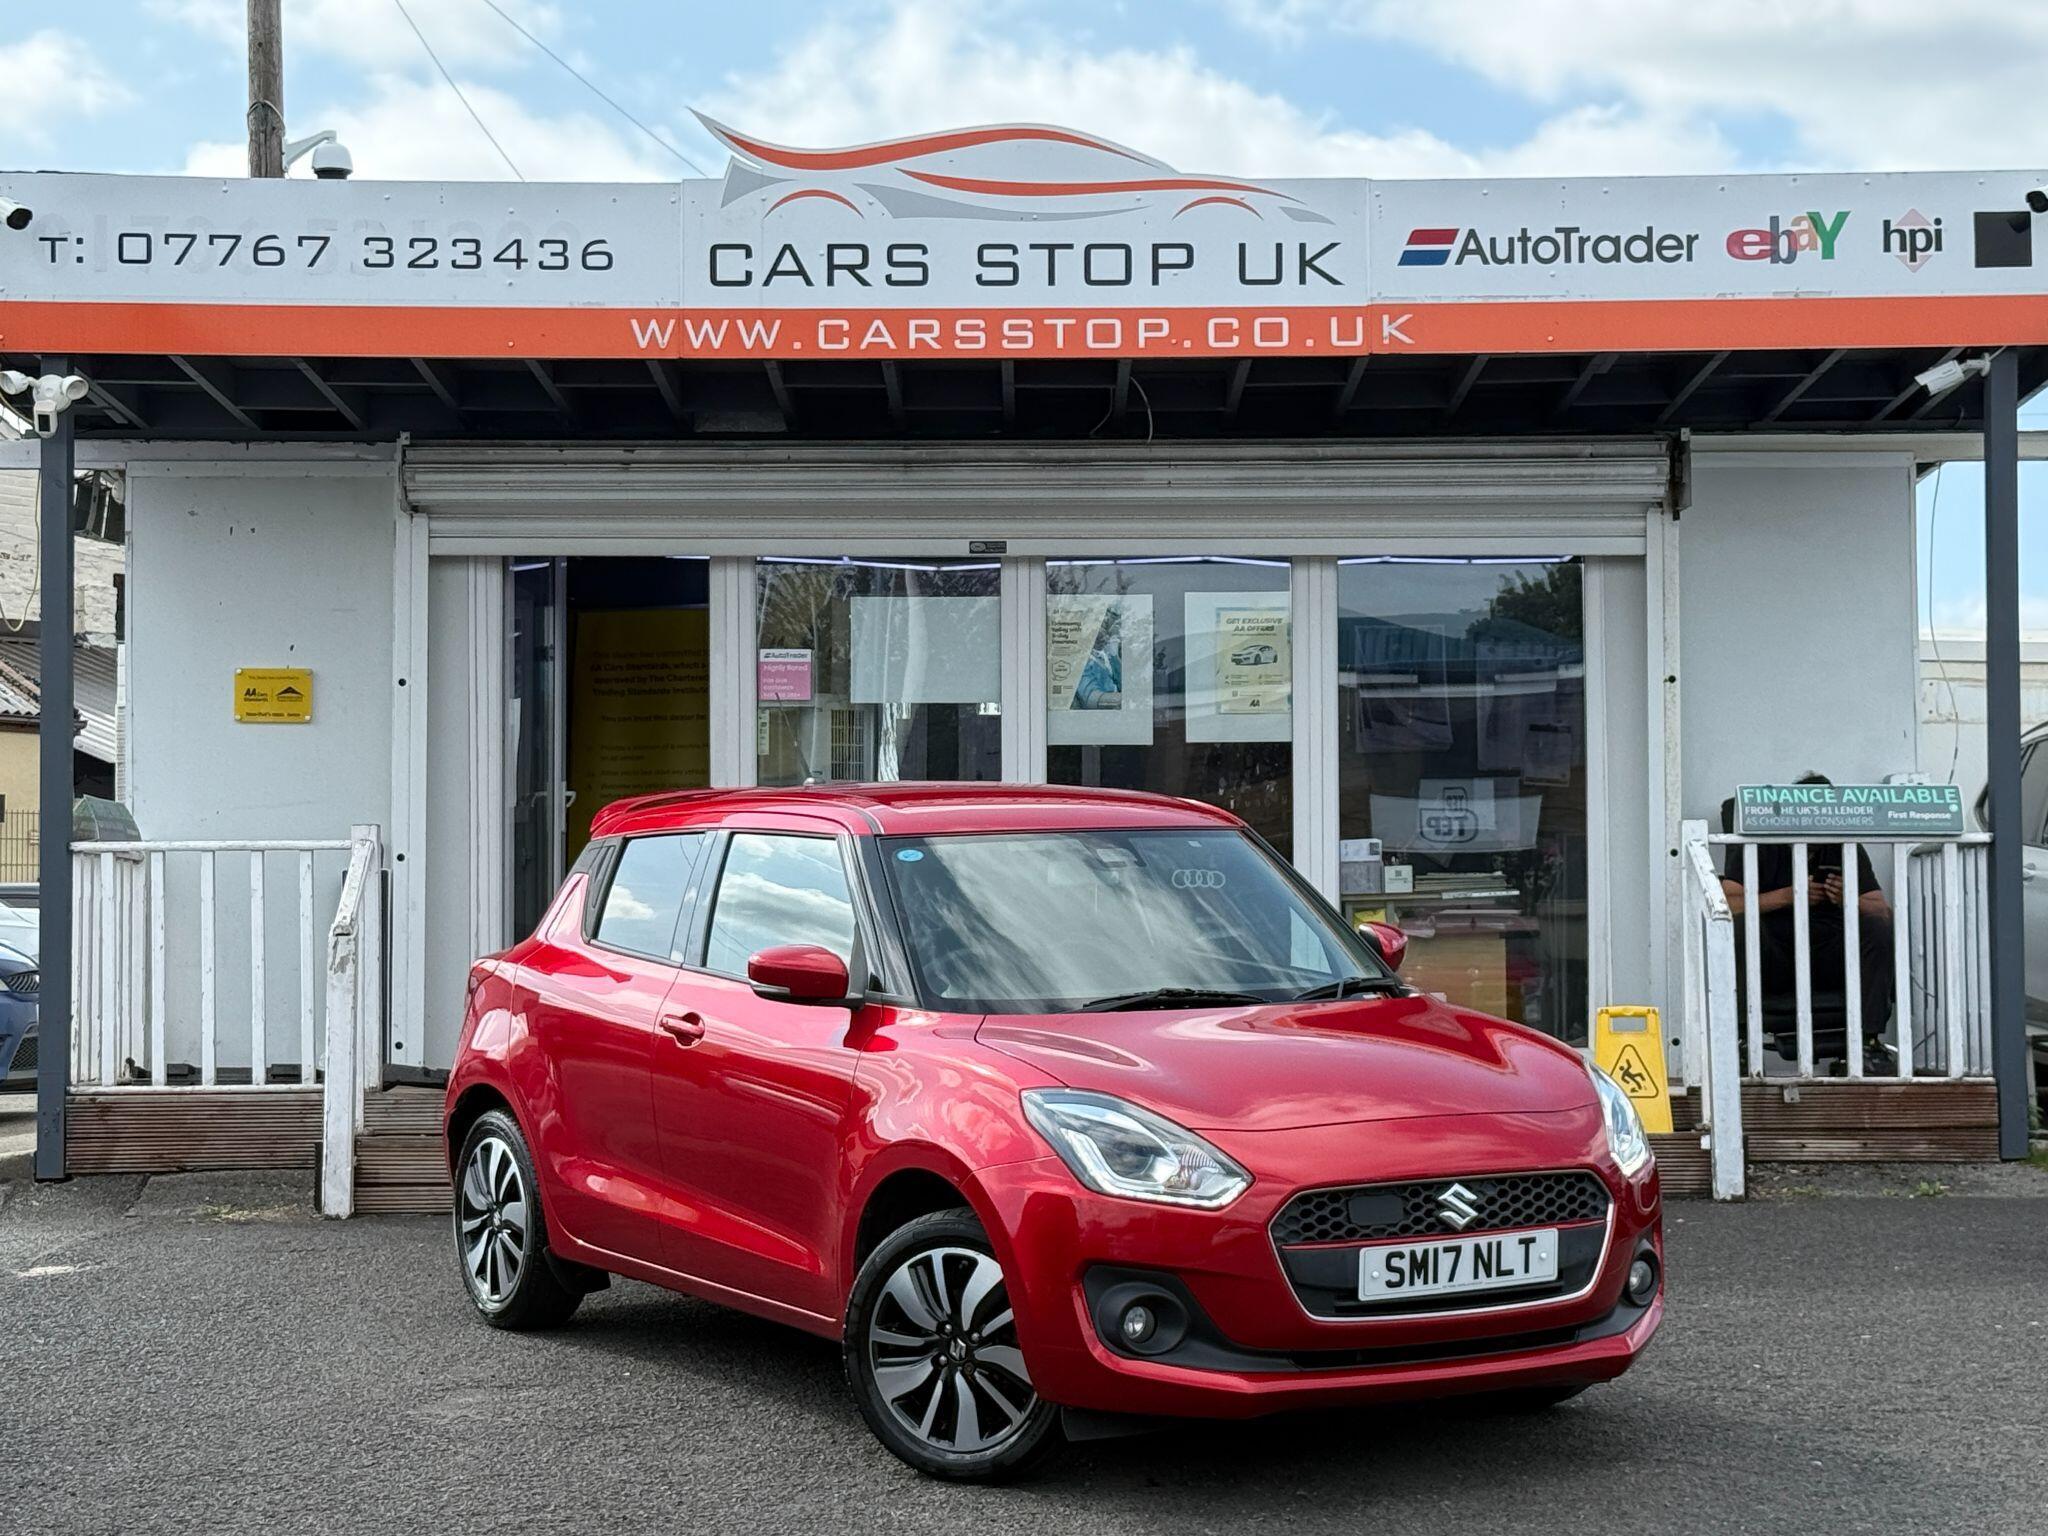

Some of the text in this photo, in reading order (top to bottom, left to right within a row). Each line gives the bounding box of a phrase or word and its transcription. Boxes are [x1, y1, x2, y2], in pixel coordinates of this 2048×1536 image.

[38, 232, 615, 271] T: 07767 323436
[1454, 225, 1700, 266] AutoTrader
[1882, 215, 1944, 268] hpi
[707, 240, 1345, 288] CARS STOP UK
[628, 312, 1418, 354] WWW.CARSSTOP.CO.UK
[1241, 617, 1284, 625] EXCLUSIVE
[244, 688, 257, 697] AA
[1742, 787, 1958, 804] FINANCE AVAILABLE
[1744, 806, 1774, 815] FROM
[1796, 806, 1820, 815] UK'S
[1820, 806, 1833, 815] #1
[1834, 805, 1874, 815] LENDER
[1744, 816, 1875, 826] AS CHOSEN BY CONSUMERS
[1887, 810, 1953, 821] First Response
[1384, 1235, 1538, 1289] SM17 NLT
